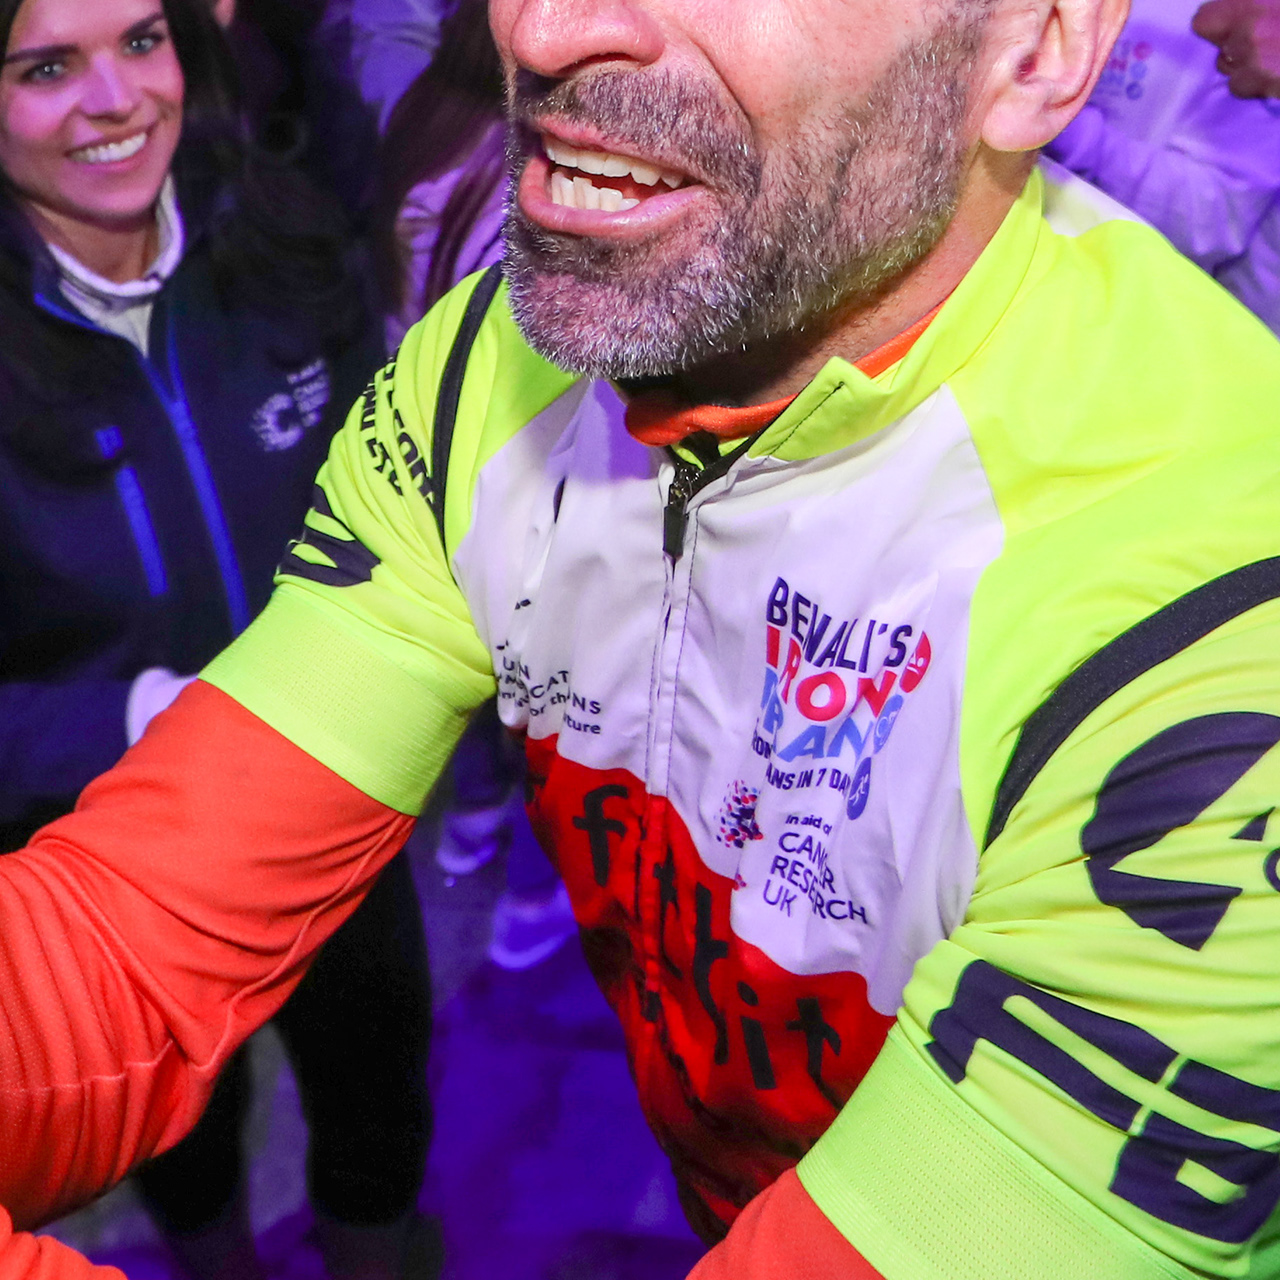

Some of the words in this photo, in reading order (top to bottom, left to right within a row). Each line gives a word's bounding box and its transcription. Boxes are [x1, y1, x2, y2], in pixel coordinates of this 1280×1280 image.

[766, 576, 913, 674] BENALI'S
[766, 624, 898, 722] IRON
[796, 768, 814, 789] IN
[816, 767, 827, 787] 7
[801, 814, 823, 829] aid
[763, 878, 798, 918] UK
[770, 854, 868, 925] RESERCH
